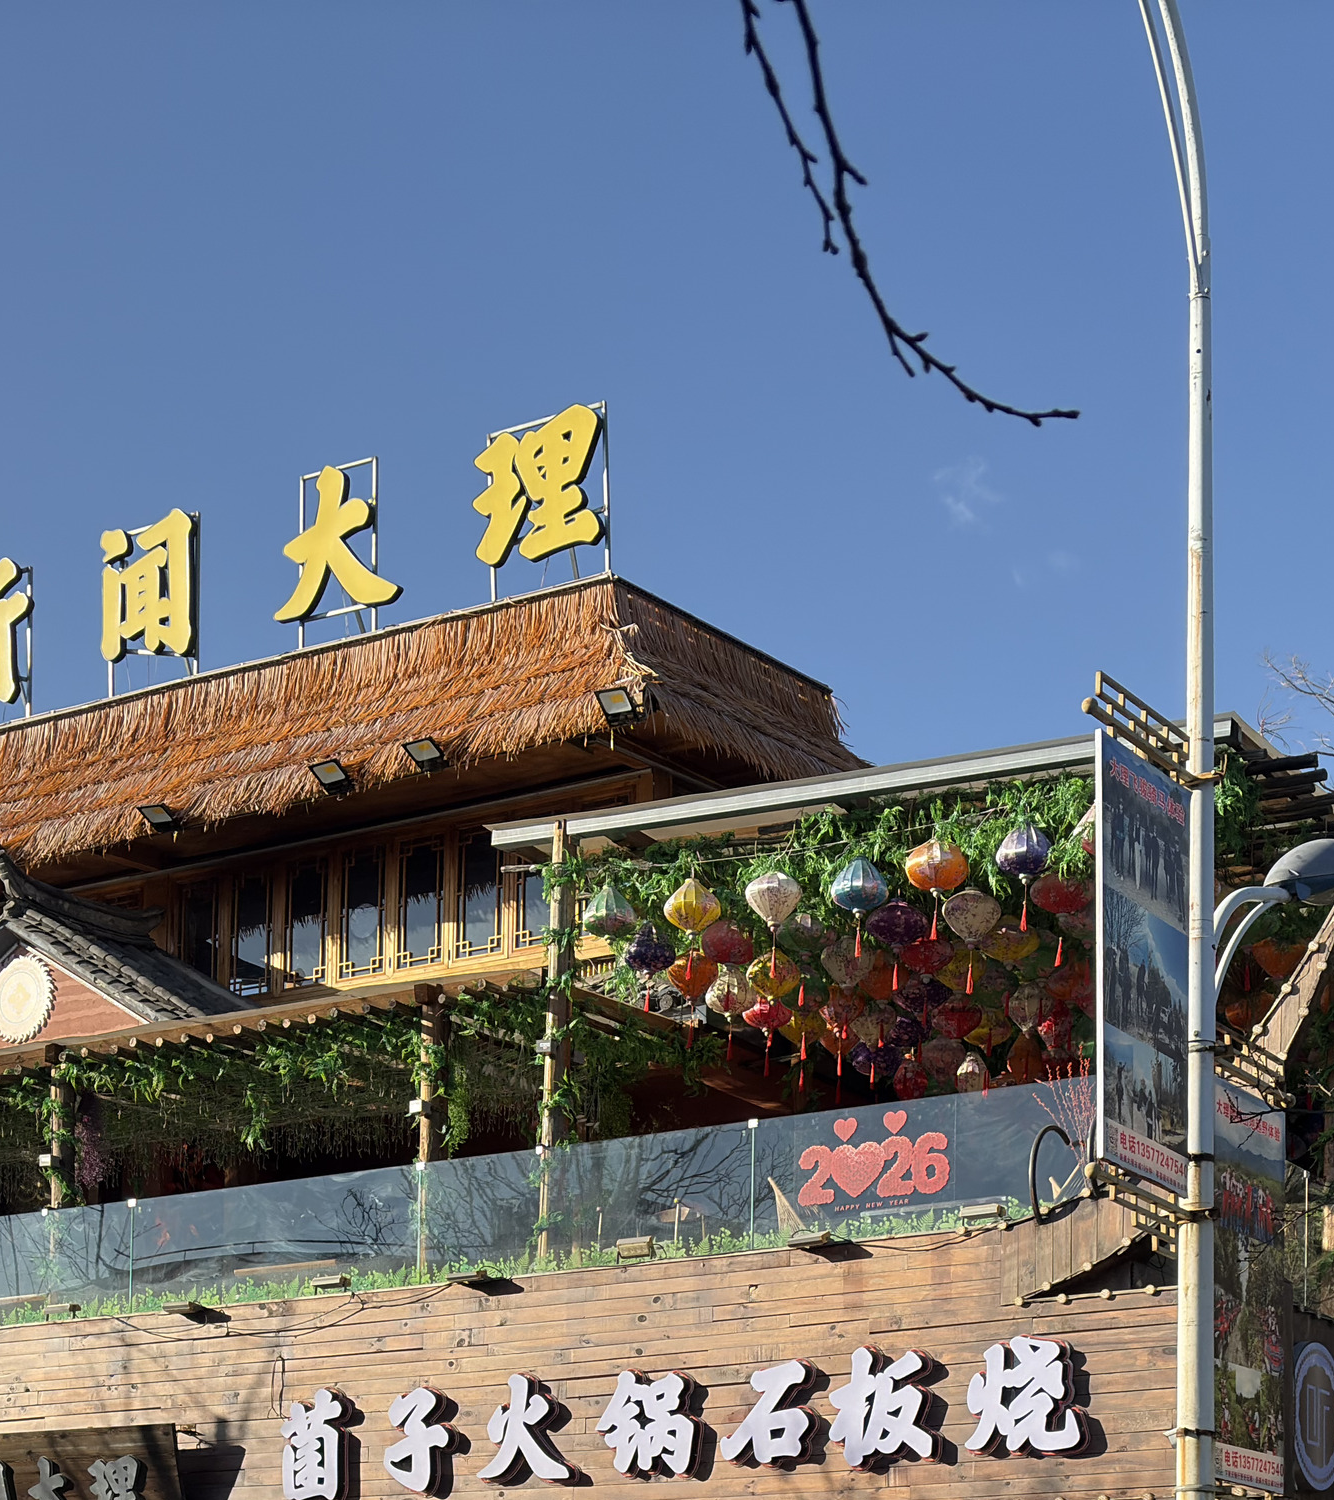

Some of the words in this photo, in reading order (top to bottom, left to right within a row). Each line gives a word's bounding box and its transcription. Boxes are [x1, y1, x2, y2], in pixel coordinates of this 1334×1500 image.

[834, 1203, 860, 1212] HAPPY
[865, 1201, 884, 1209] NEW
[889, 1198, 910, 1206] YEAR
